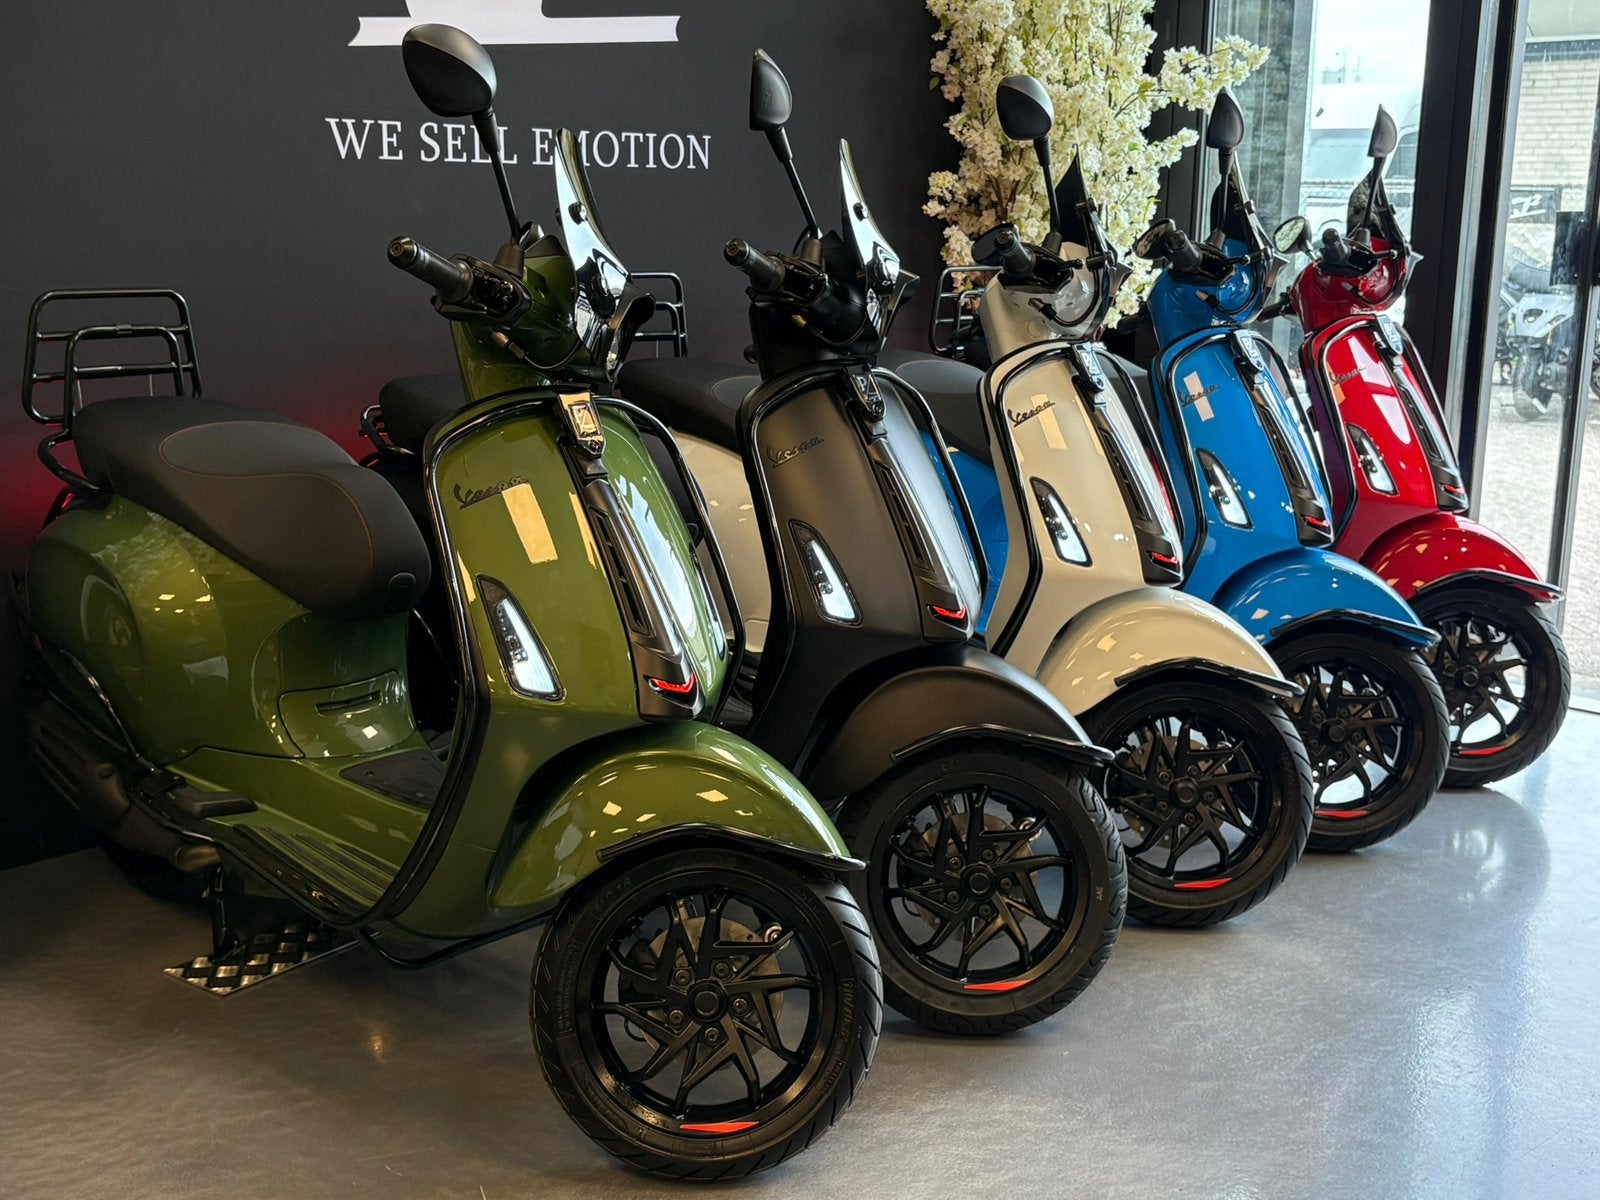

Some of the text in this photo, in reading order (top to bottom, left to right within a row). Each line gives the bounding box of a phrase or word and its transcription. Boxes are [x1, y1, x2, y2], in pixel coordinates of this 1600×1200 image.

[325, 117, 404, 161] WE
[419, 121, 518, 165] SELL
[1006, 400, 1056, 429] Vespa
[766, 436, 825, 469] Vespa
[453, 475, 530, 511] Vespa
